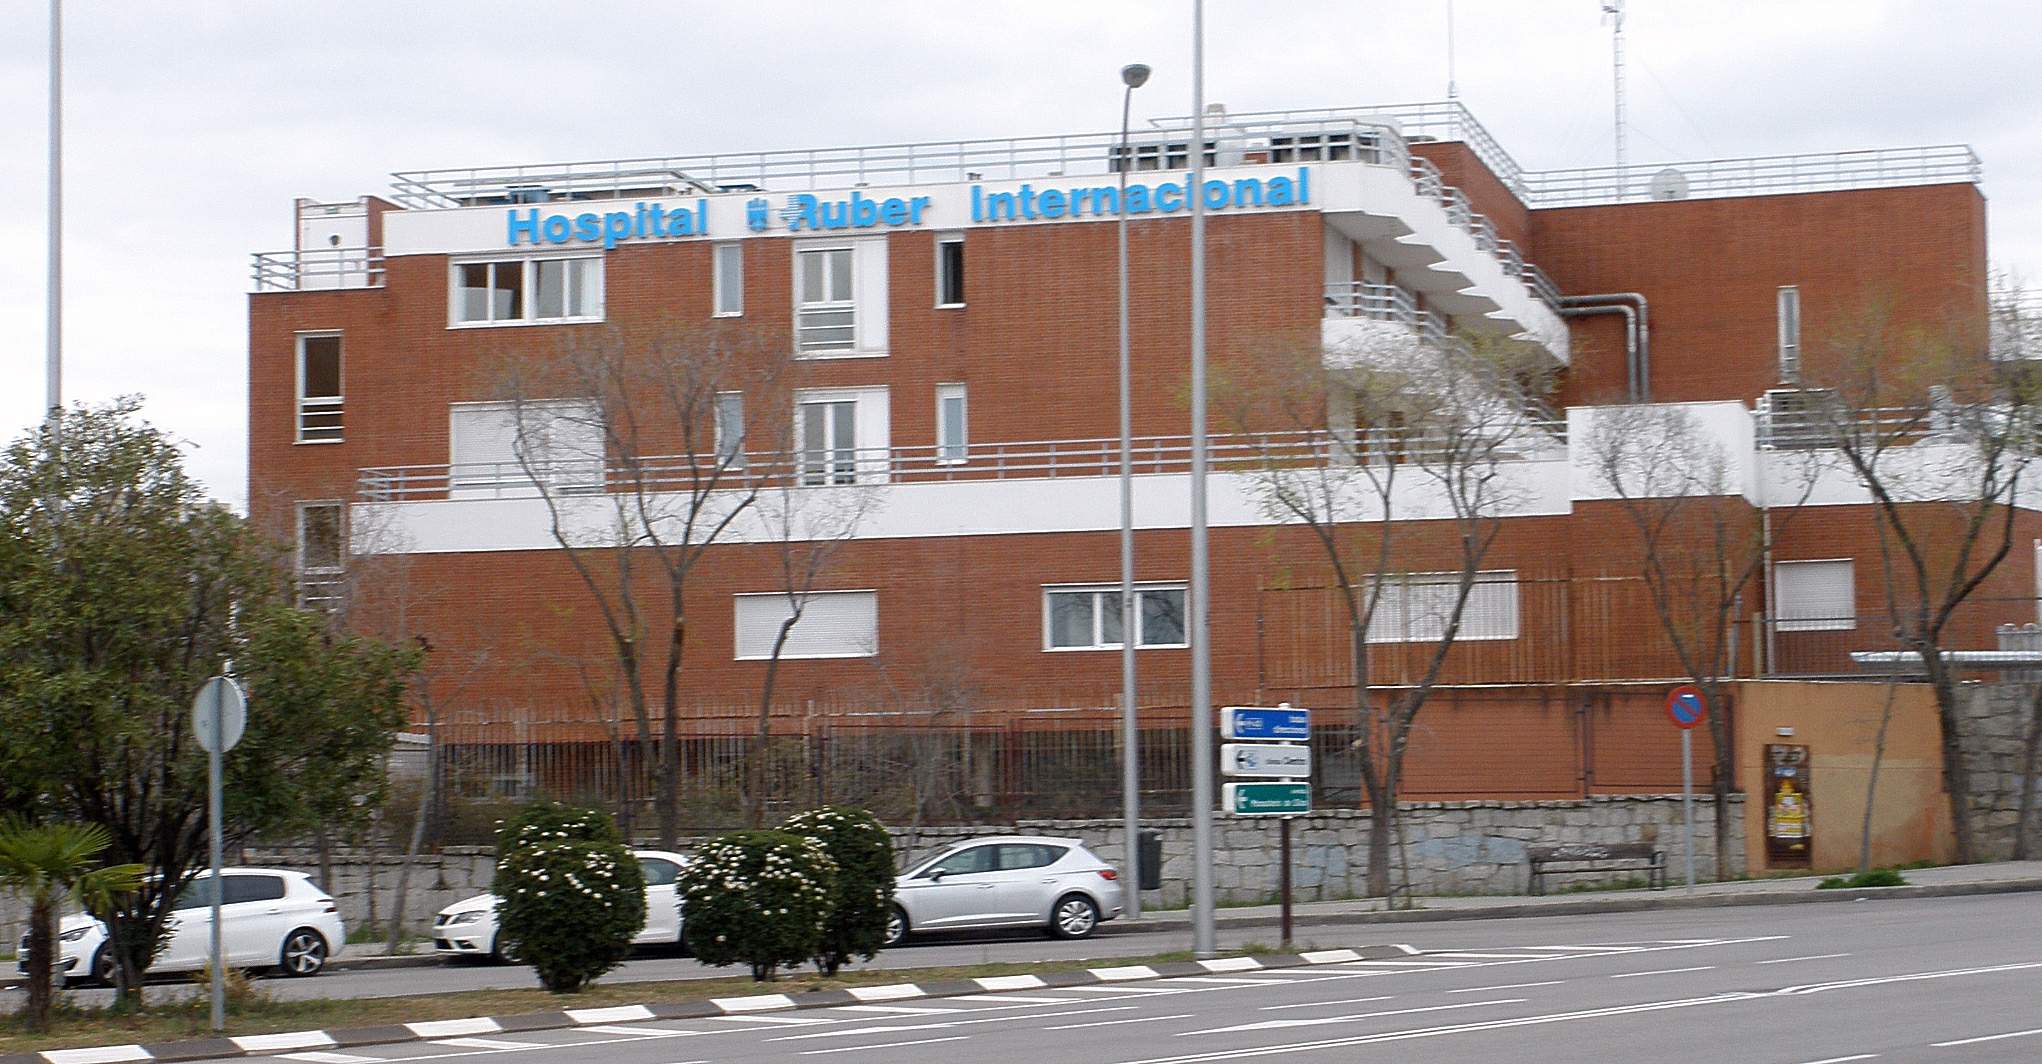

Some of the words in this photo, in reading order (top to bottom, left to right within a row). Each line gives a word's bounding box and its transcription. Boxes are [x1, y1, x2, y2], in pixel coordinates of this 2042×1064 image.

[507, 197, 709, 251] Hospital
[782, 190, 931, 232] Ruber
[970, 166, 1310, 223] Internacional
